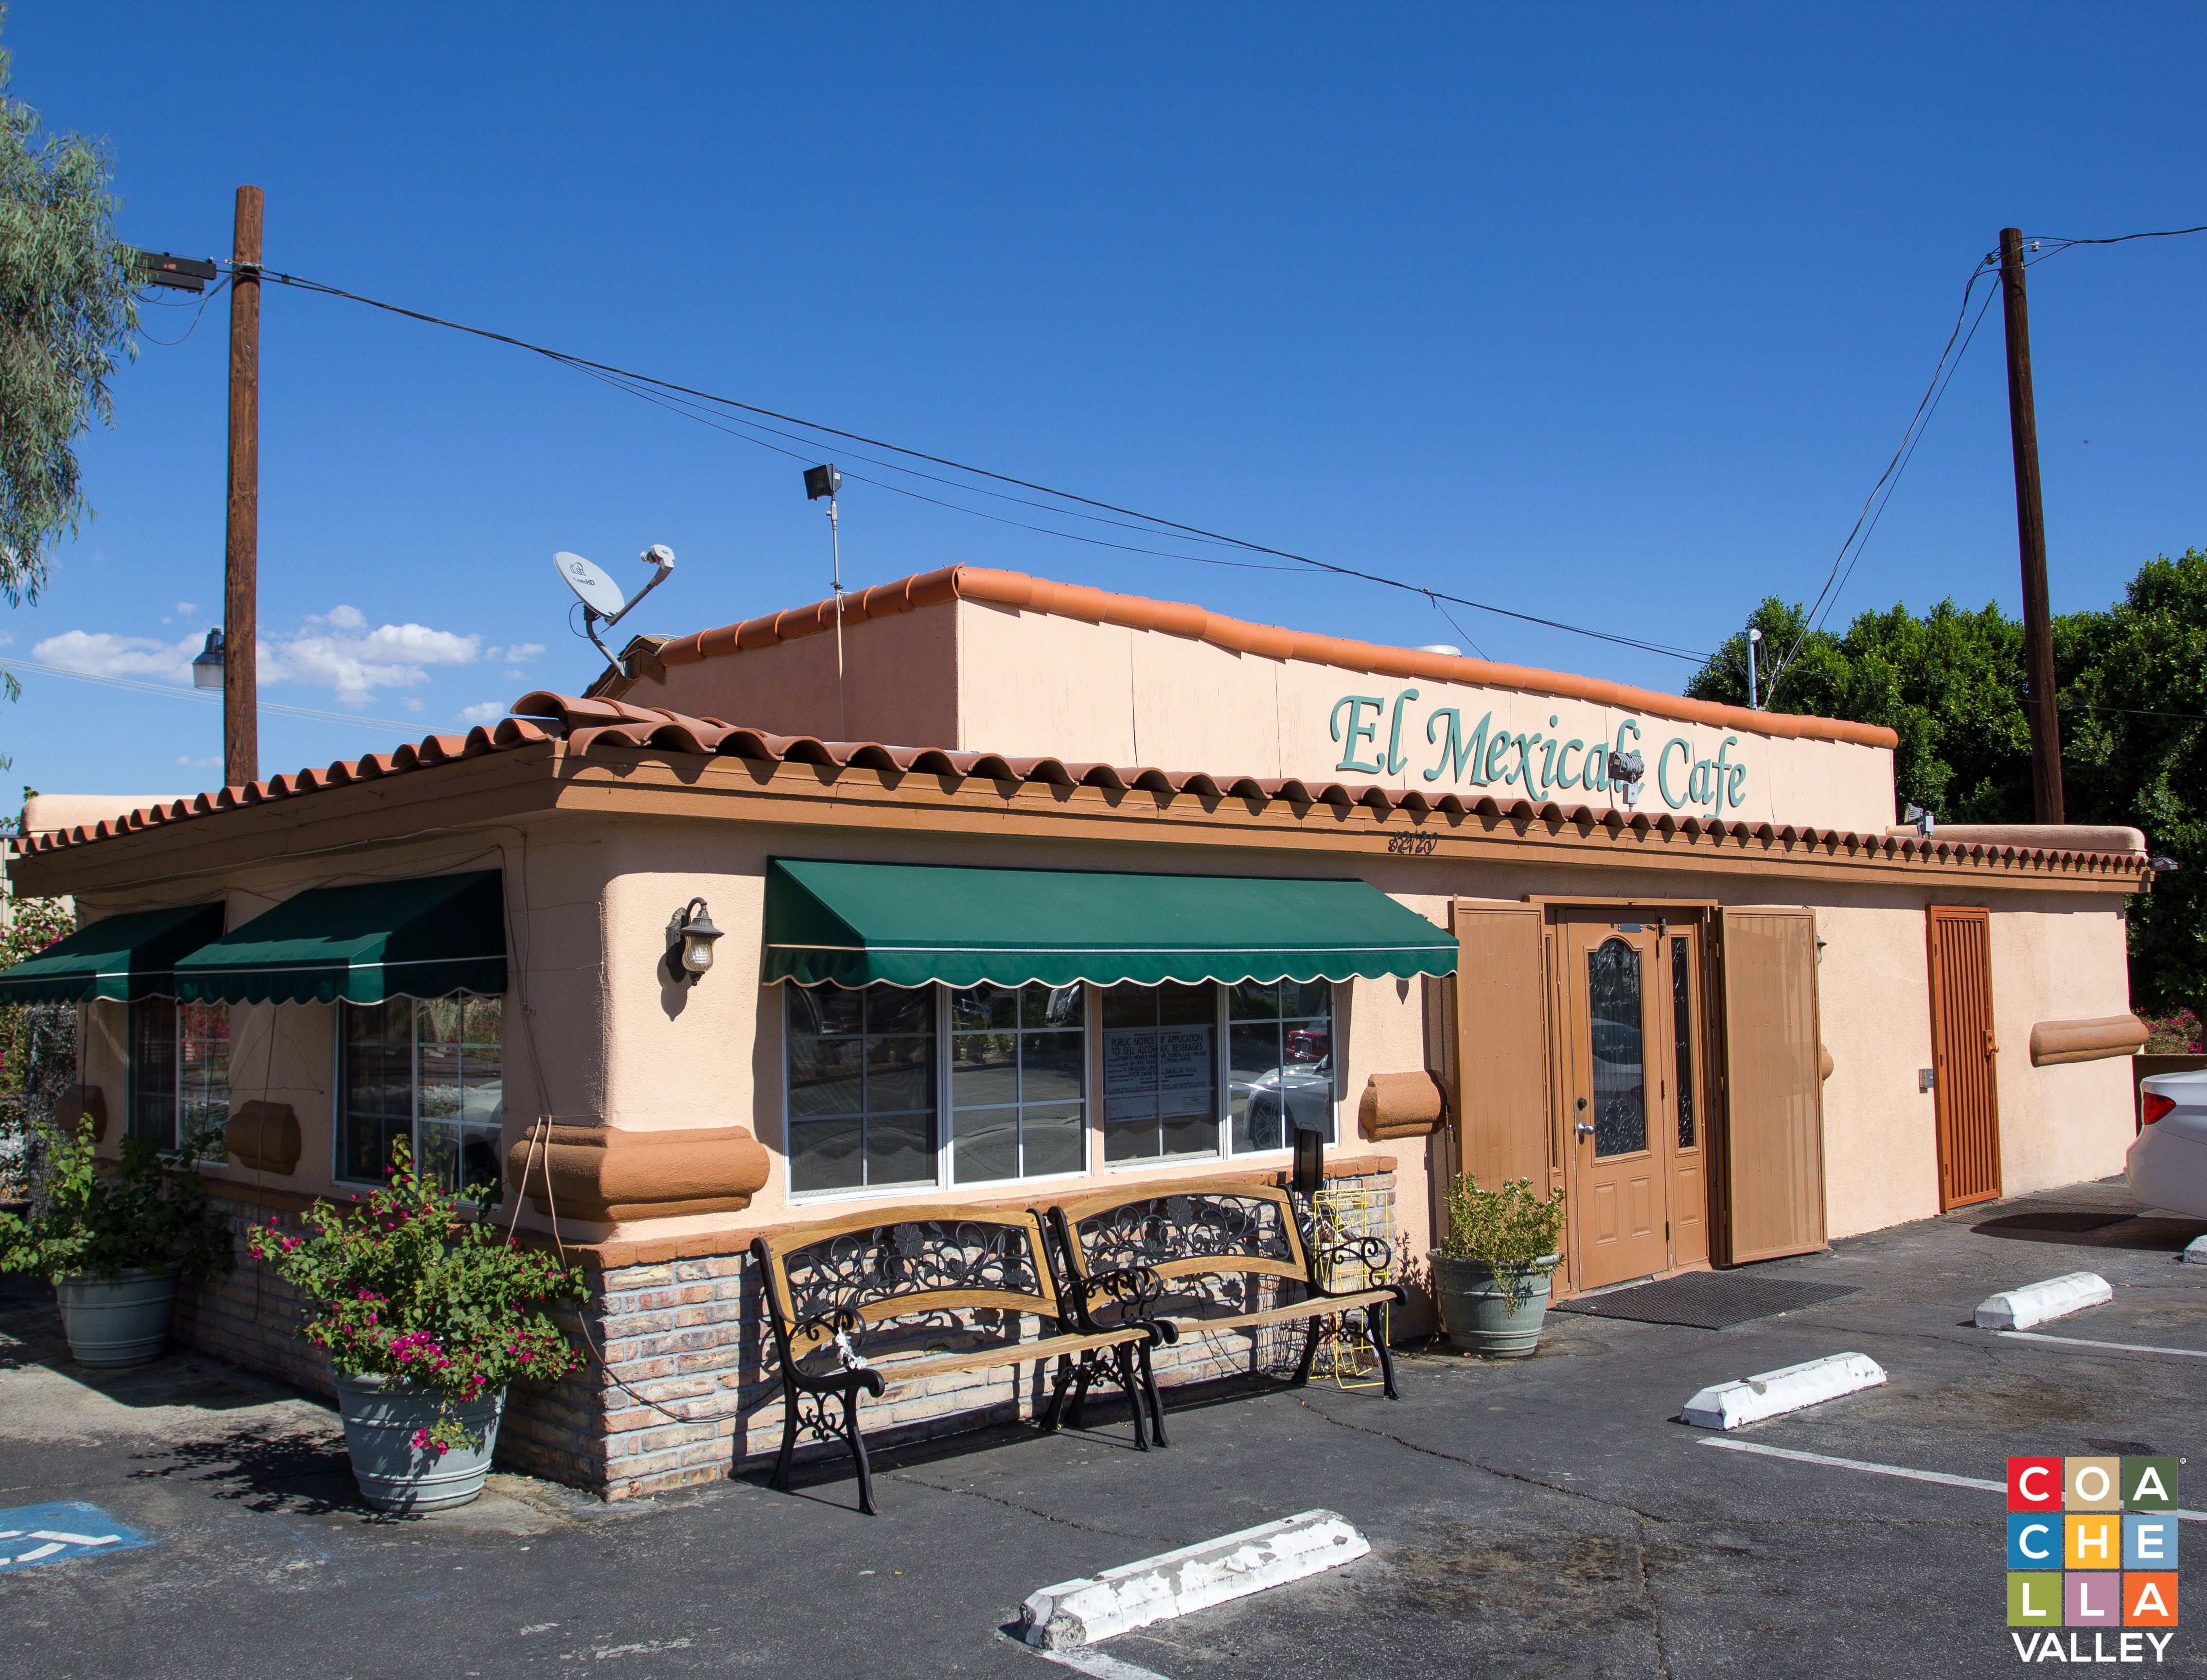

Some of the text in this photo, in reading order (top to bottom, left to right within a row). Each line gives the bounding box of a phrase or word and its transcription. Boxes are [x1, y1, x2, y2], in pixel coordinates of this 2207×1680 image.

[569, 562, 587, 576] dish
[1330, 688, 1419, 776] El
[1658, 736, 1747, 819] Cafe
[1112, 1037, 1130, 1047] PUBLIC
[1134, 1036, 1154, 1046] NOTICE
[1168, 1034, 1202, 1044] APPLICATION
[1112, 1047, 1120, 1056] TO
[1123, 1047, 1135, 1055] SELL
[1172, 1042, 1202, 1052] BEVERAGES
